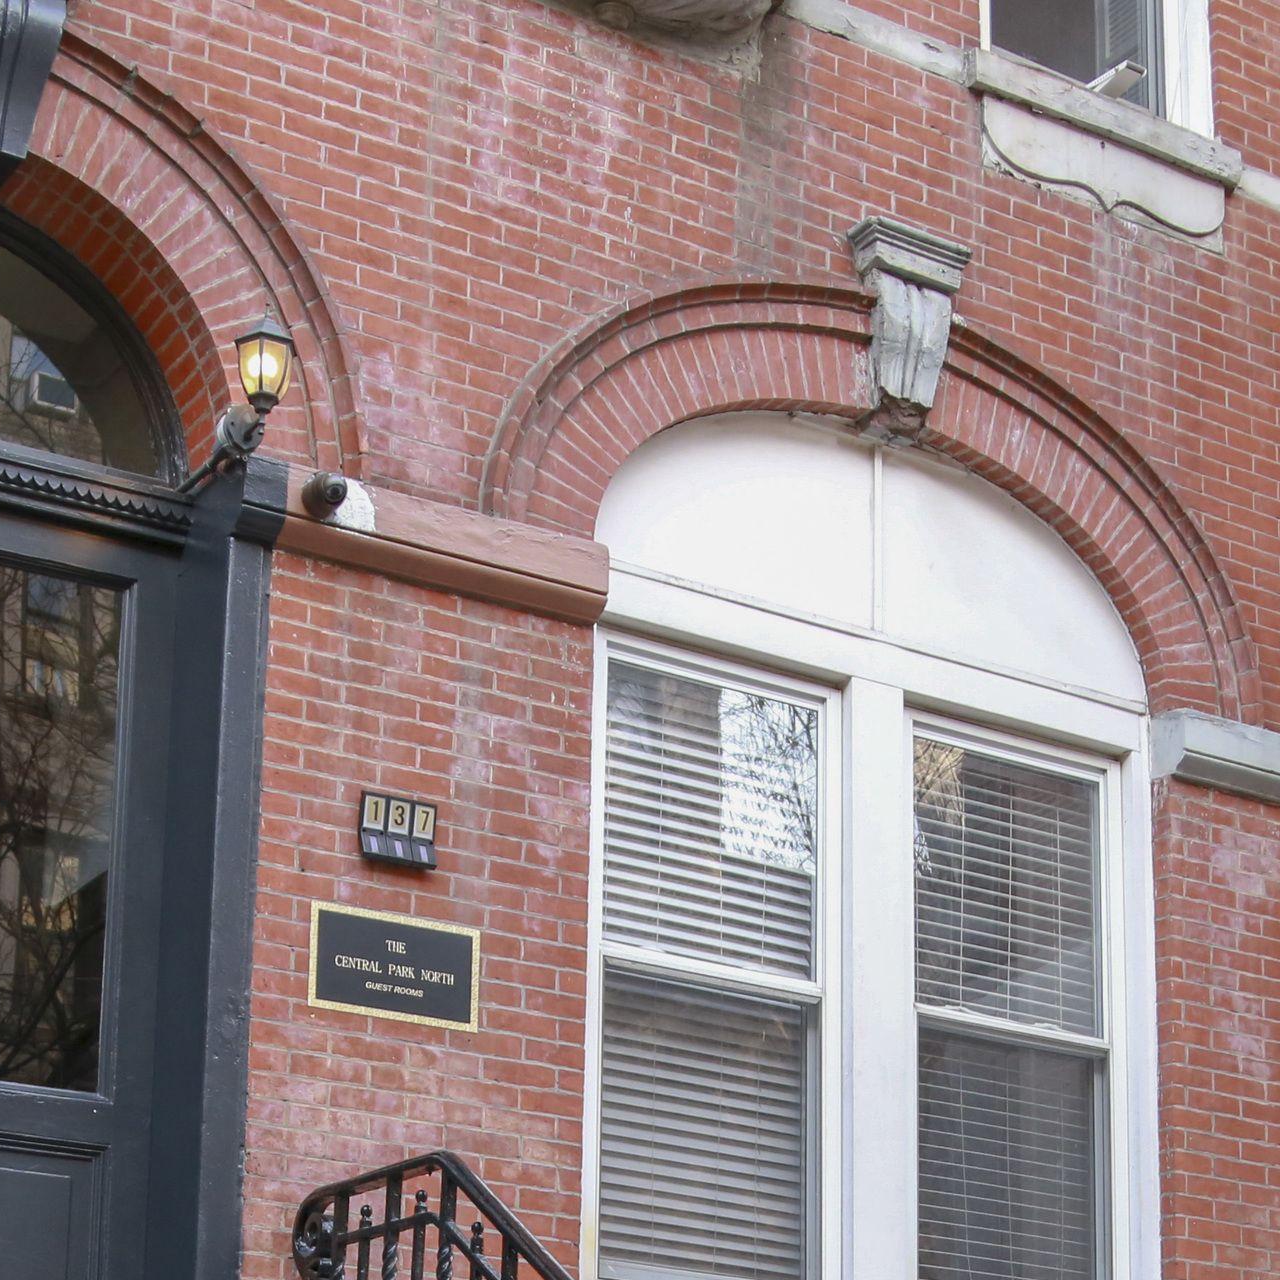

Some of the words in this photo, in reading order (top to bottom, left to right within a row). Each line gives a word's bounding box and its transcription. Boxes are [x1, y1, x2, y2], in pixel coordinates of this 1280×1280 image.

[372, 798, 430, 832] 137
[385, 939, 407, 954] THE
[334, 954, 382, 974] CENTRAL
[388, 963, 415, 980] PARK
[421, 968, 454, 986] NORTH
[365, 980, 394, 993] GUEST
[393, 984, 424, 998] ROOMS
